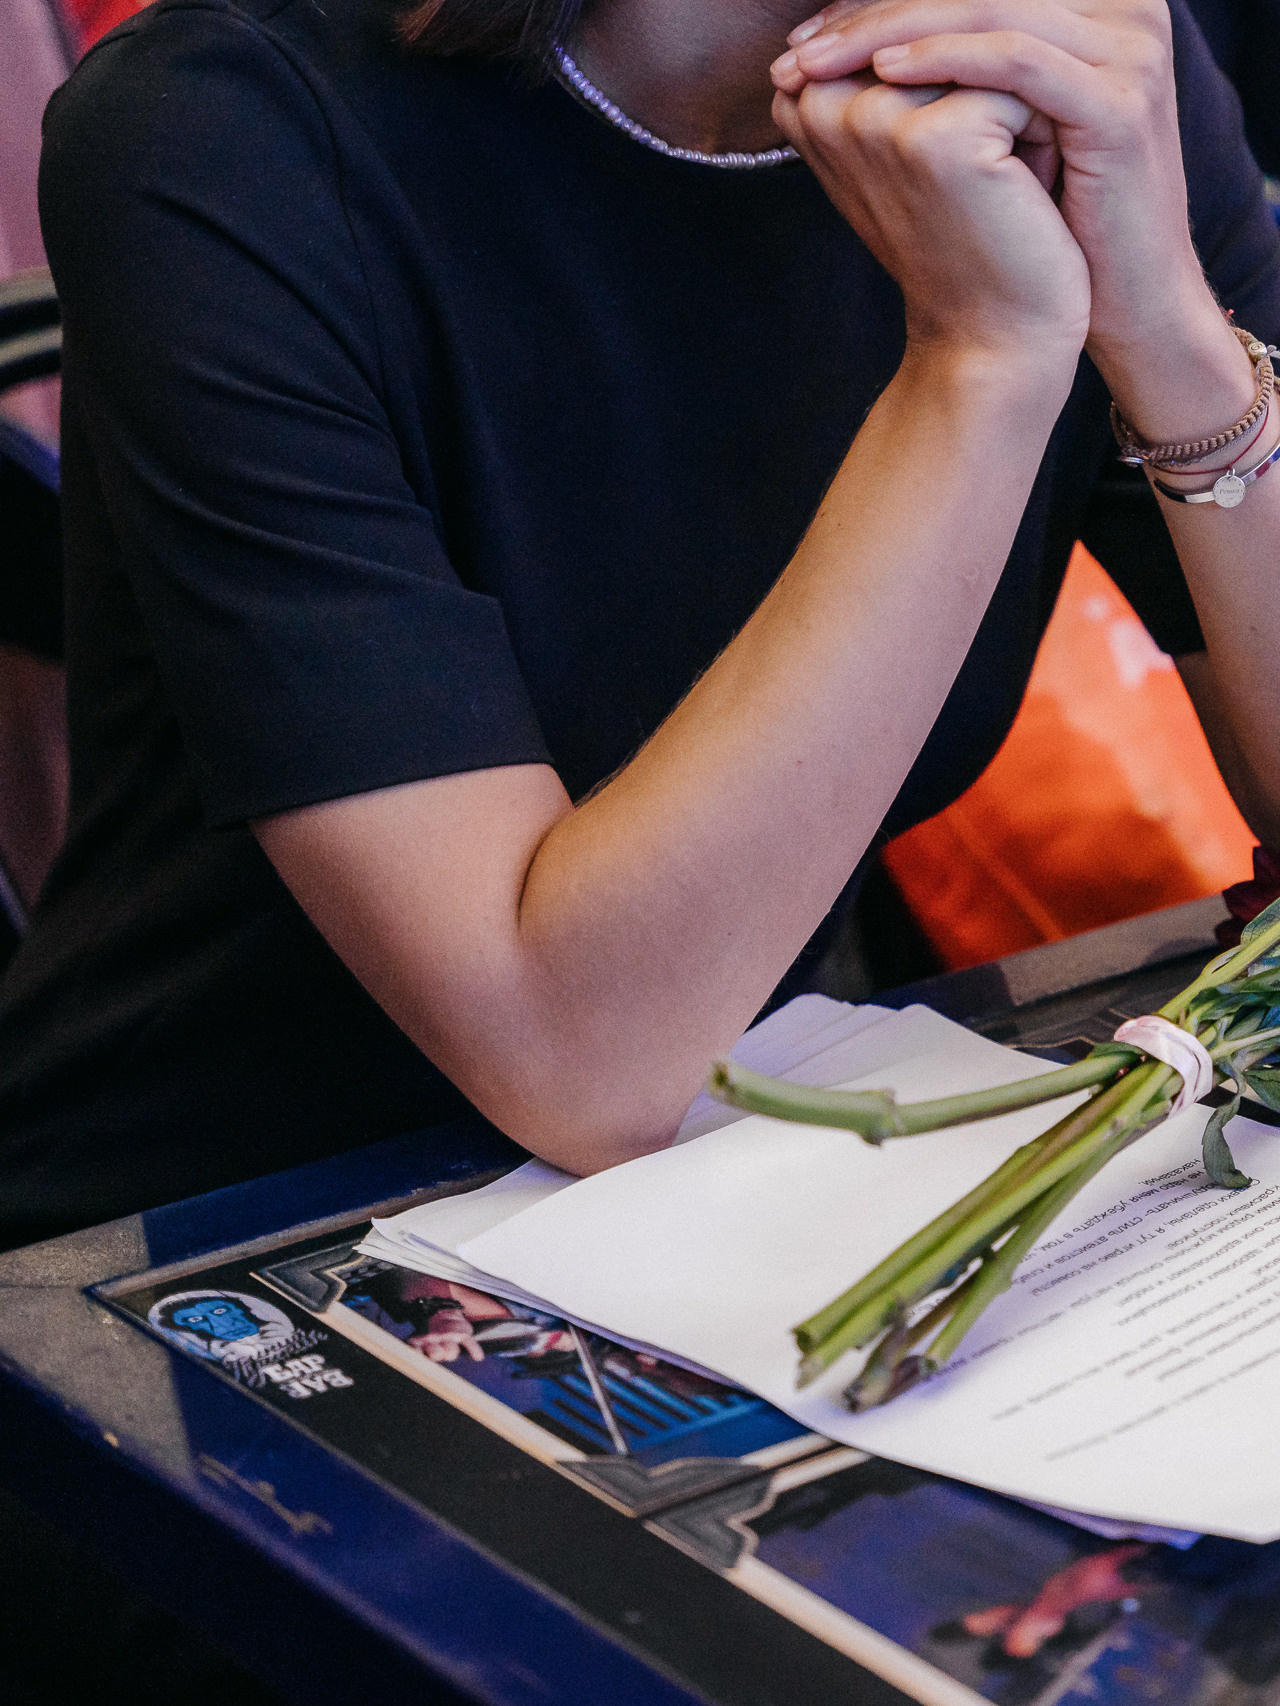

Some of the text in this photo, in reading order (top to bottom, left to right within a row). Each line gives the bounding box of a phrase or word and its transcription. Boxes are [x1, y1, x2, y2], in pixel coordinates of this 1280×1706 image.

[1137, 1158, 1202, 1187] наказаний.
[1157, 1178, 1190, 1190] надо
[1215, 1178, 1264, 1203] Свки
[1126, 1188, 1160, 1202] меня
[1069, 1200, 1135, 1233] убеждать
[1161, 1200, 1220, 1227] сделаны,
[1214, 1213, 1256, 1233] рядом
[1104, 1216, 1146, 1236] стиль
[1239, 1226, 1266, 1239] они
[1032, 1237, 1065, 1252] том,
[1129, 1231, 1158, 1244] тут
[1160, 1232, 1219, 1262] мужчины
[1052, 1235, 1111, 1264] атеистов
[1094, 1242, 1138, 1263] играю
[1163, 1239, 1244, 1281] вдохновляют
[1203, 1248, 1265, 1280] здоровых
[1011, 1268, 1047, 1284] слаб
